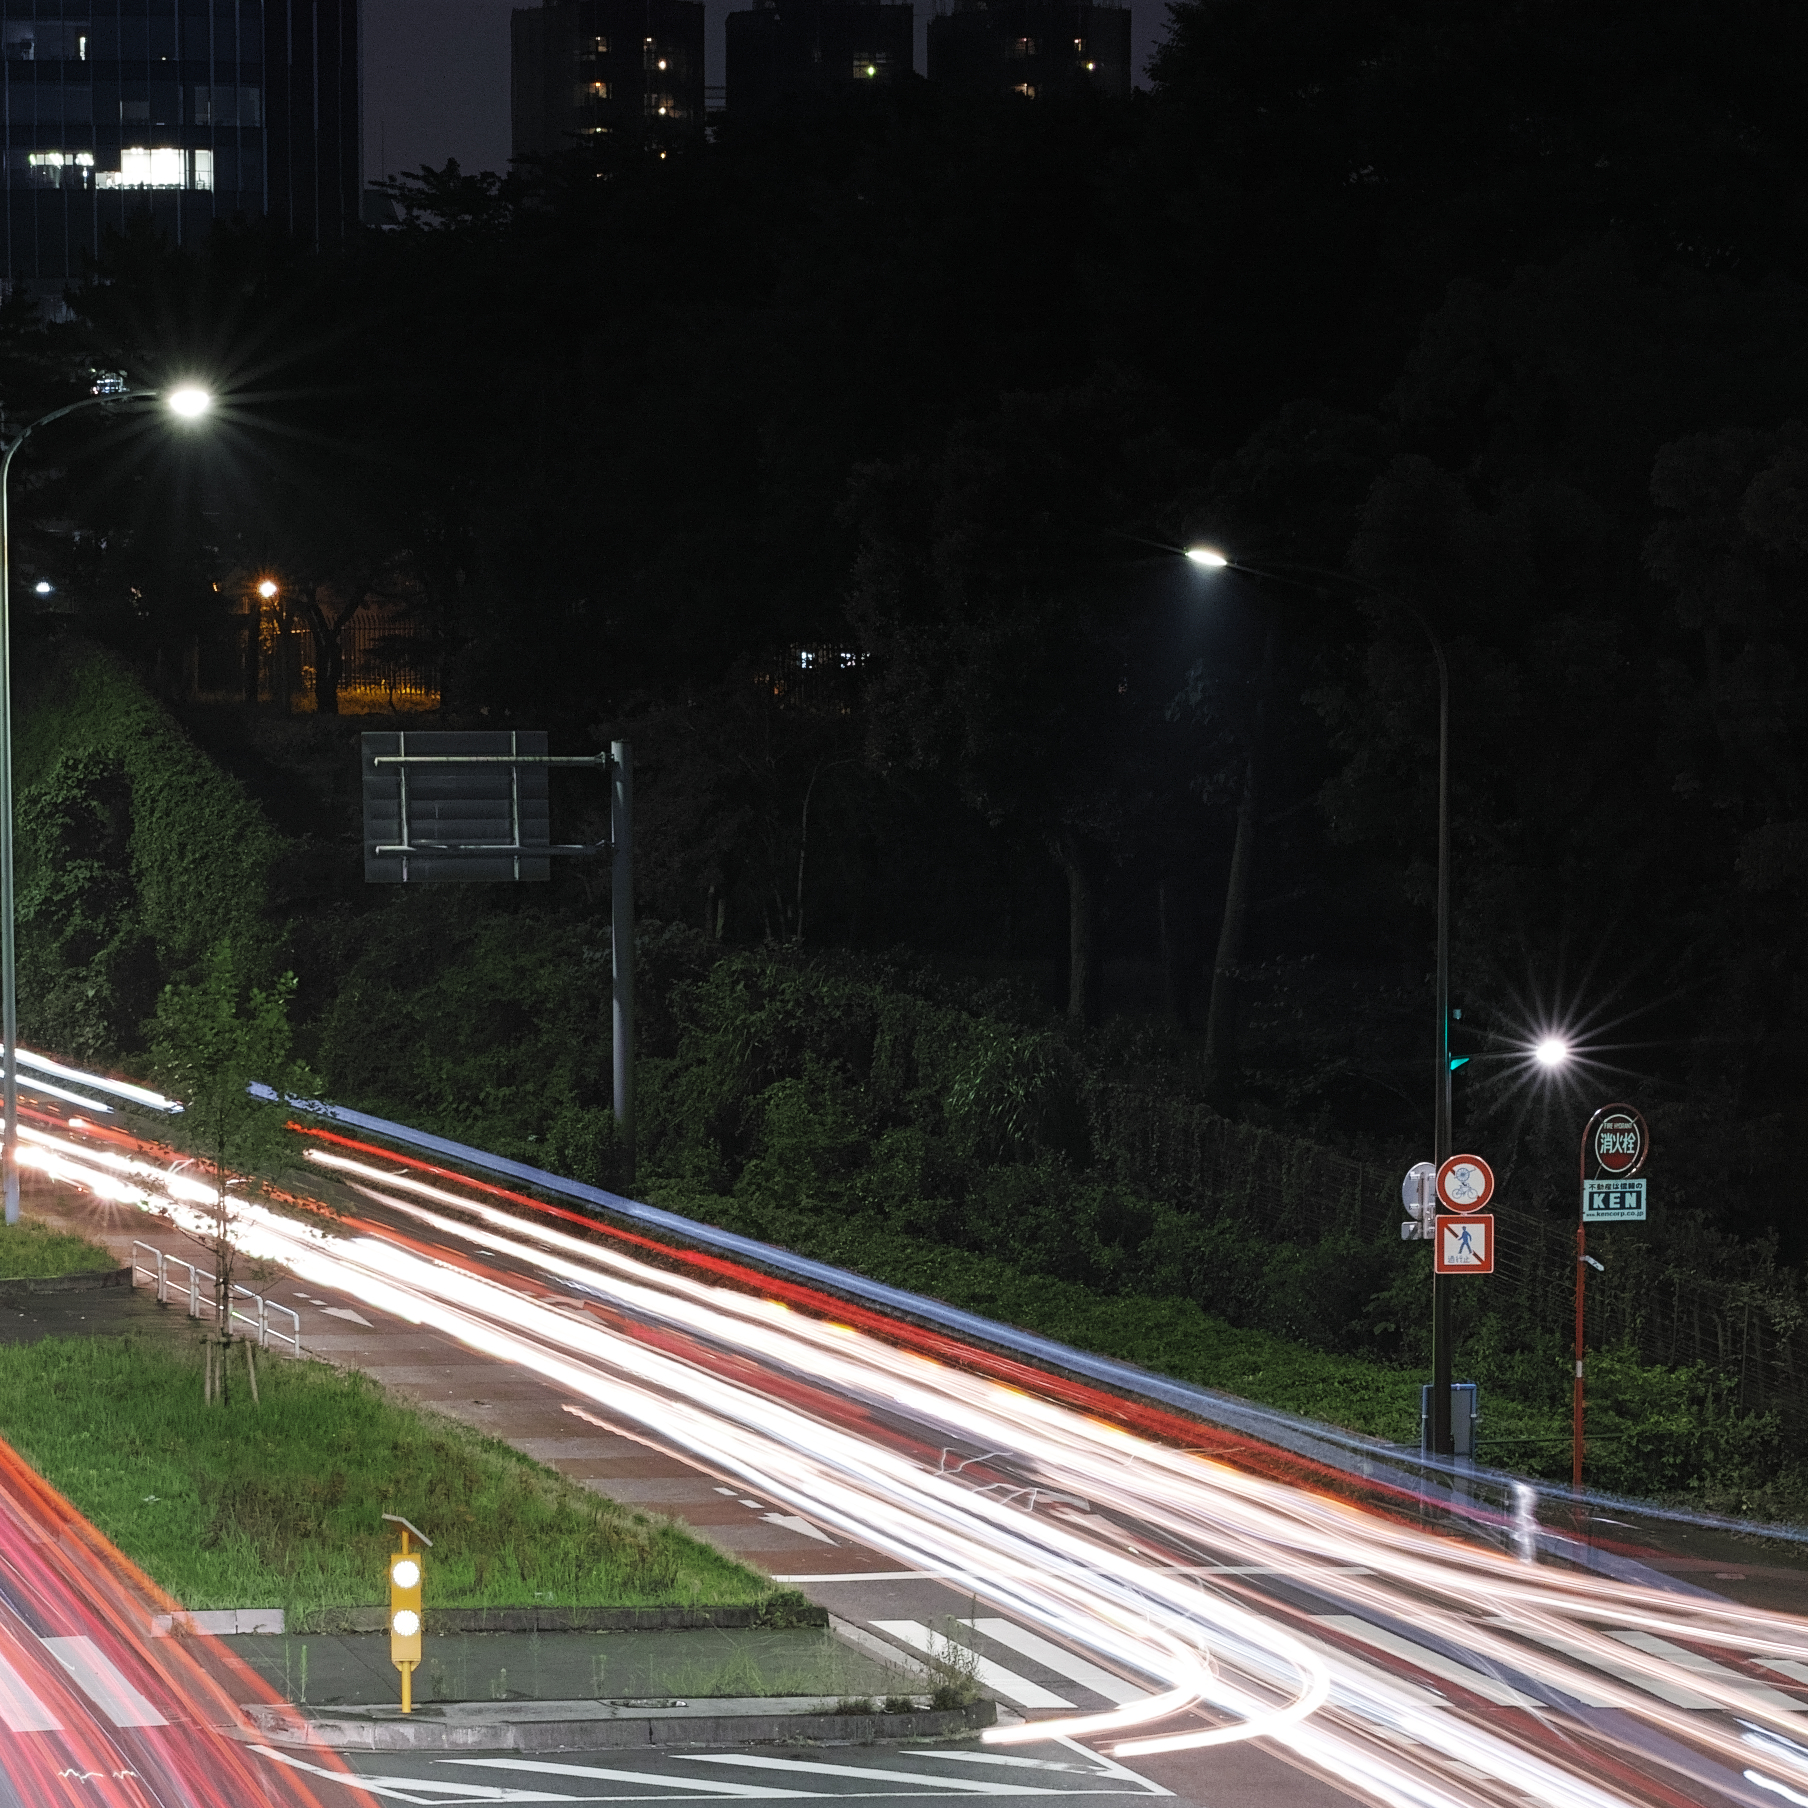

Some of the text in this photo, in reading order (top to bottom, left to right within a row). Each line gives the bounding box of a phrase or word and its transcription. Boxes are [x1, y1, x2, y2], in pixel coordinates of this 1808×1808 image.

[1603, 1122, 1613, 1130] FIRE
[1599, 1131, 1637, 1154] 消火栓
[1592, 1192, 1638, 1209] KEN
